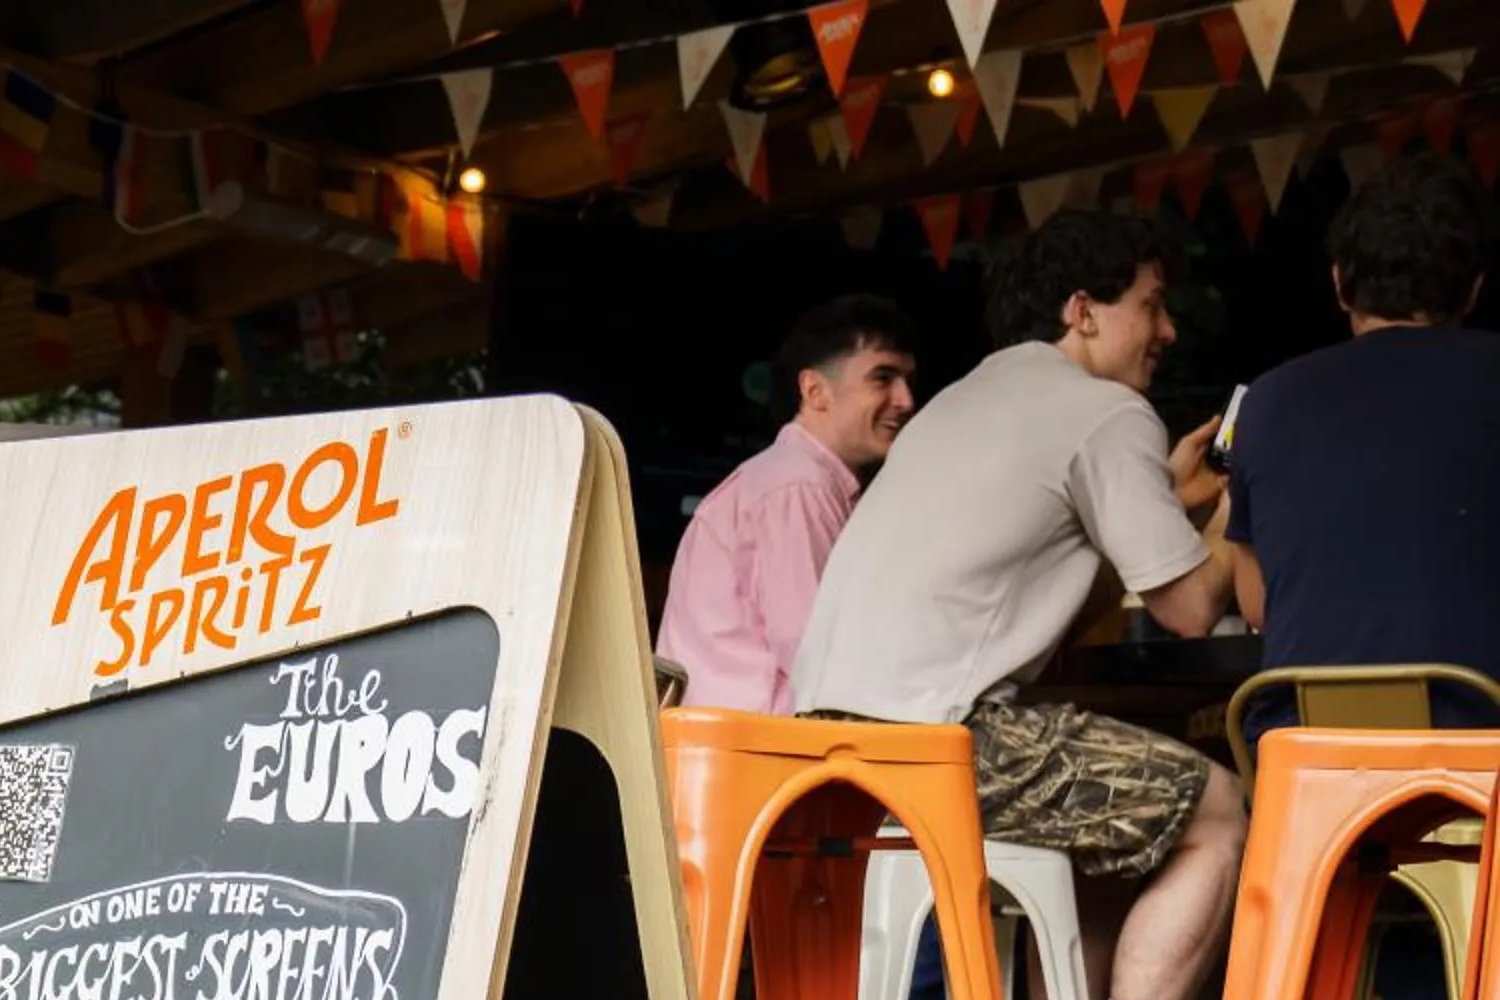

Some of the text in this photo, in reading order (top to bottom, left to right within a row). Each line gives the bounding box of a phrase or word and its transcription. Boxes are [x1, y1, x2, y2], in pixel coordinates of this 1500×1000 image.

[50, 427, 399, 627] APEROL
[268, 653, 388, 719] The
[223, 704, 490, 825] EUROS
[69, 883, 269, 929] ON ONE OF THE
